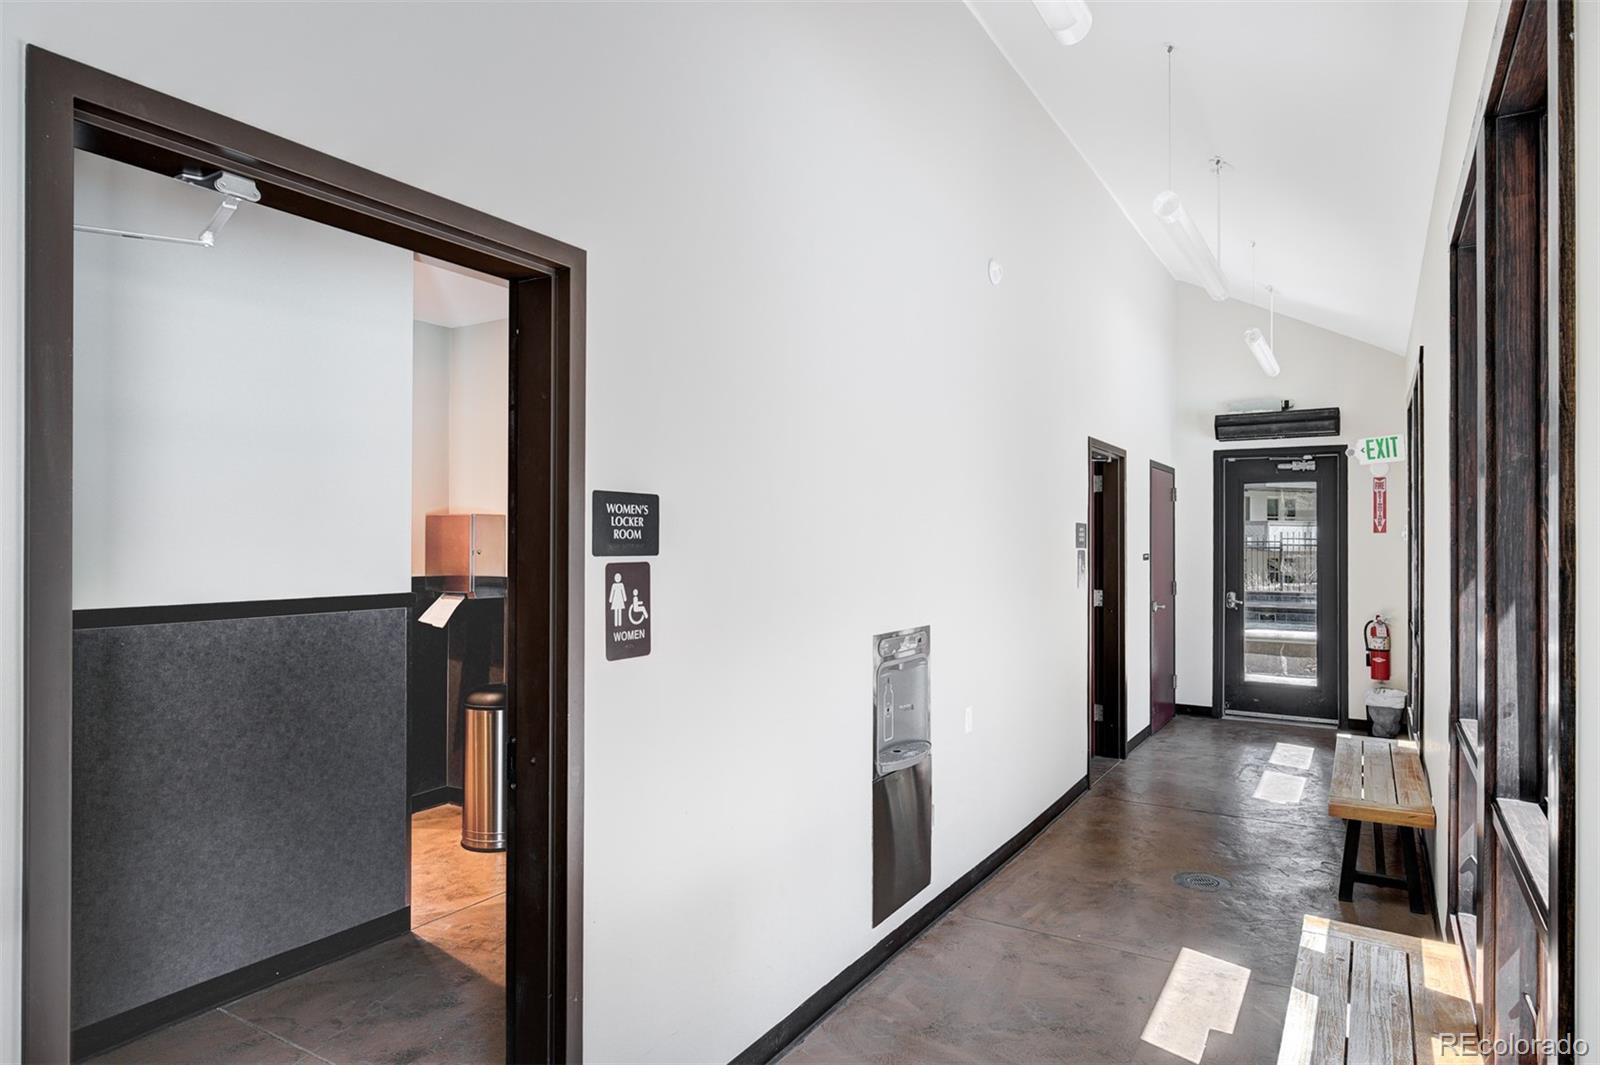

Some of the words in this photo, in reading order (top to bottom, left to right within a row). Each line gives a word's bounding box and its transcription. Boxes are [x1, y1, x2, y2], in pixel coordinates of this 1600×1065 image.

[1365, 436, 1398, 460] EXIT
[606, 503, 649, 515] WOMEN'S
[611, 516, 644, 527] LOCKER
[613, 529, 642, 540] ROOM
[613, 629, 646, 642] WOMEN
